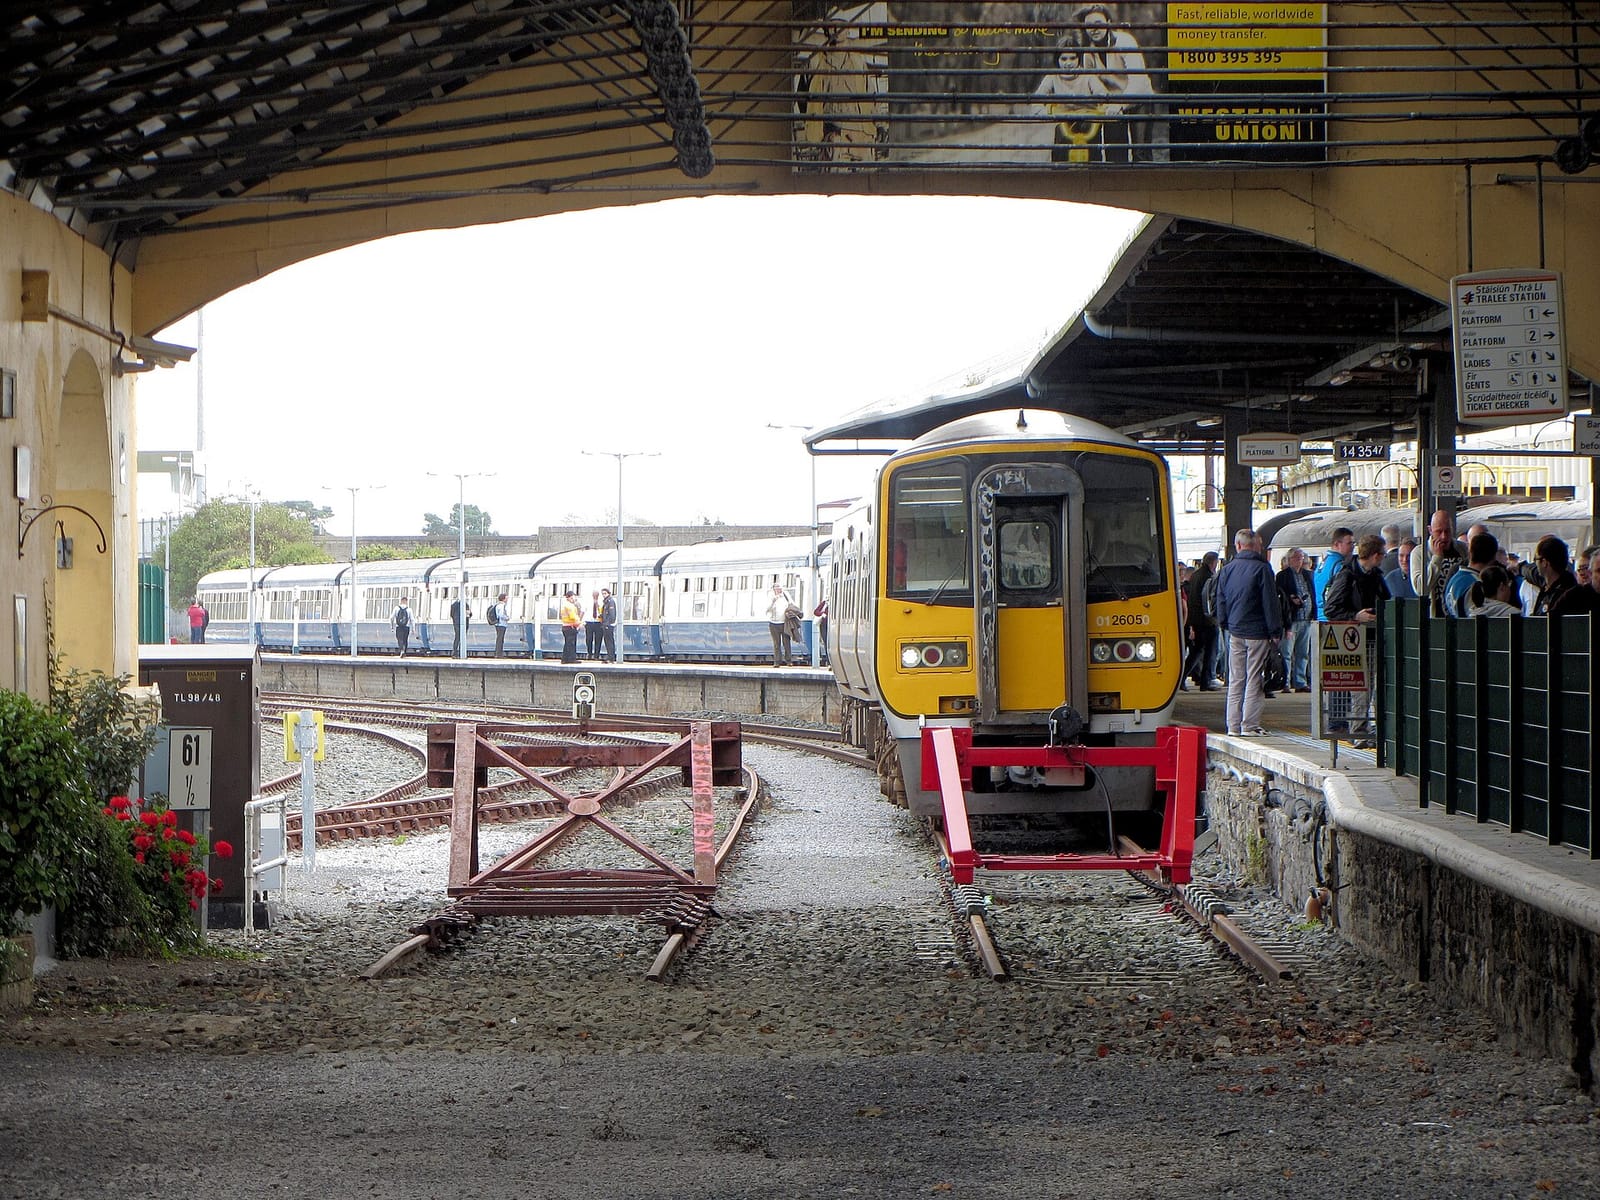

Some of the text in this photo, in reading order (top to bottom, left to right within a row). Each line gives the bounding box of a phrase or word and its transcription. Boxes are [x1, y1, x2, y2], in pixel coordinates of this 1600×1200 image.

[1177, 8, 1314, 20] Fast, reliable, worldwide
[887, 27, 948, 36] SENDING
[1177, 28, 1267, 41] money transfer.
[1178, 52, 1282, 63] 1800 395 395
[1178, 108, 1295, 123] WESTERN
[1215, 125, 1295, 140] UNION
[1475, 292, 1546, 303] TRALEE STATION
[1461, 308, 1534, 325] PLATFORM 1
[1463, 330, 1536, 347] PLATFORM 2
[1464, 359, 1491, 368] LADIES
[1466, 372, 1477, 380] Fir
[1465, 381, 1491, 390] GENTS
[1466, 401, 1530, 411] TICKET CHECKER
[1285, 445, 1289, 455] 1
[1342, 445, 1355, 458] 14
[1325, 655, 1362, 666] DANGER
[240, 672, 247, 681] F
[182, 733, 200, 766] 61
